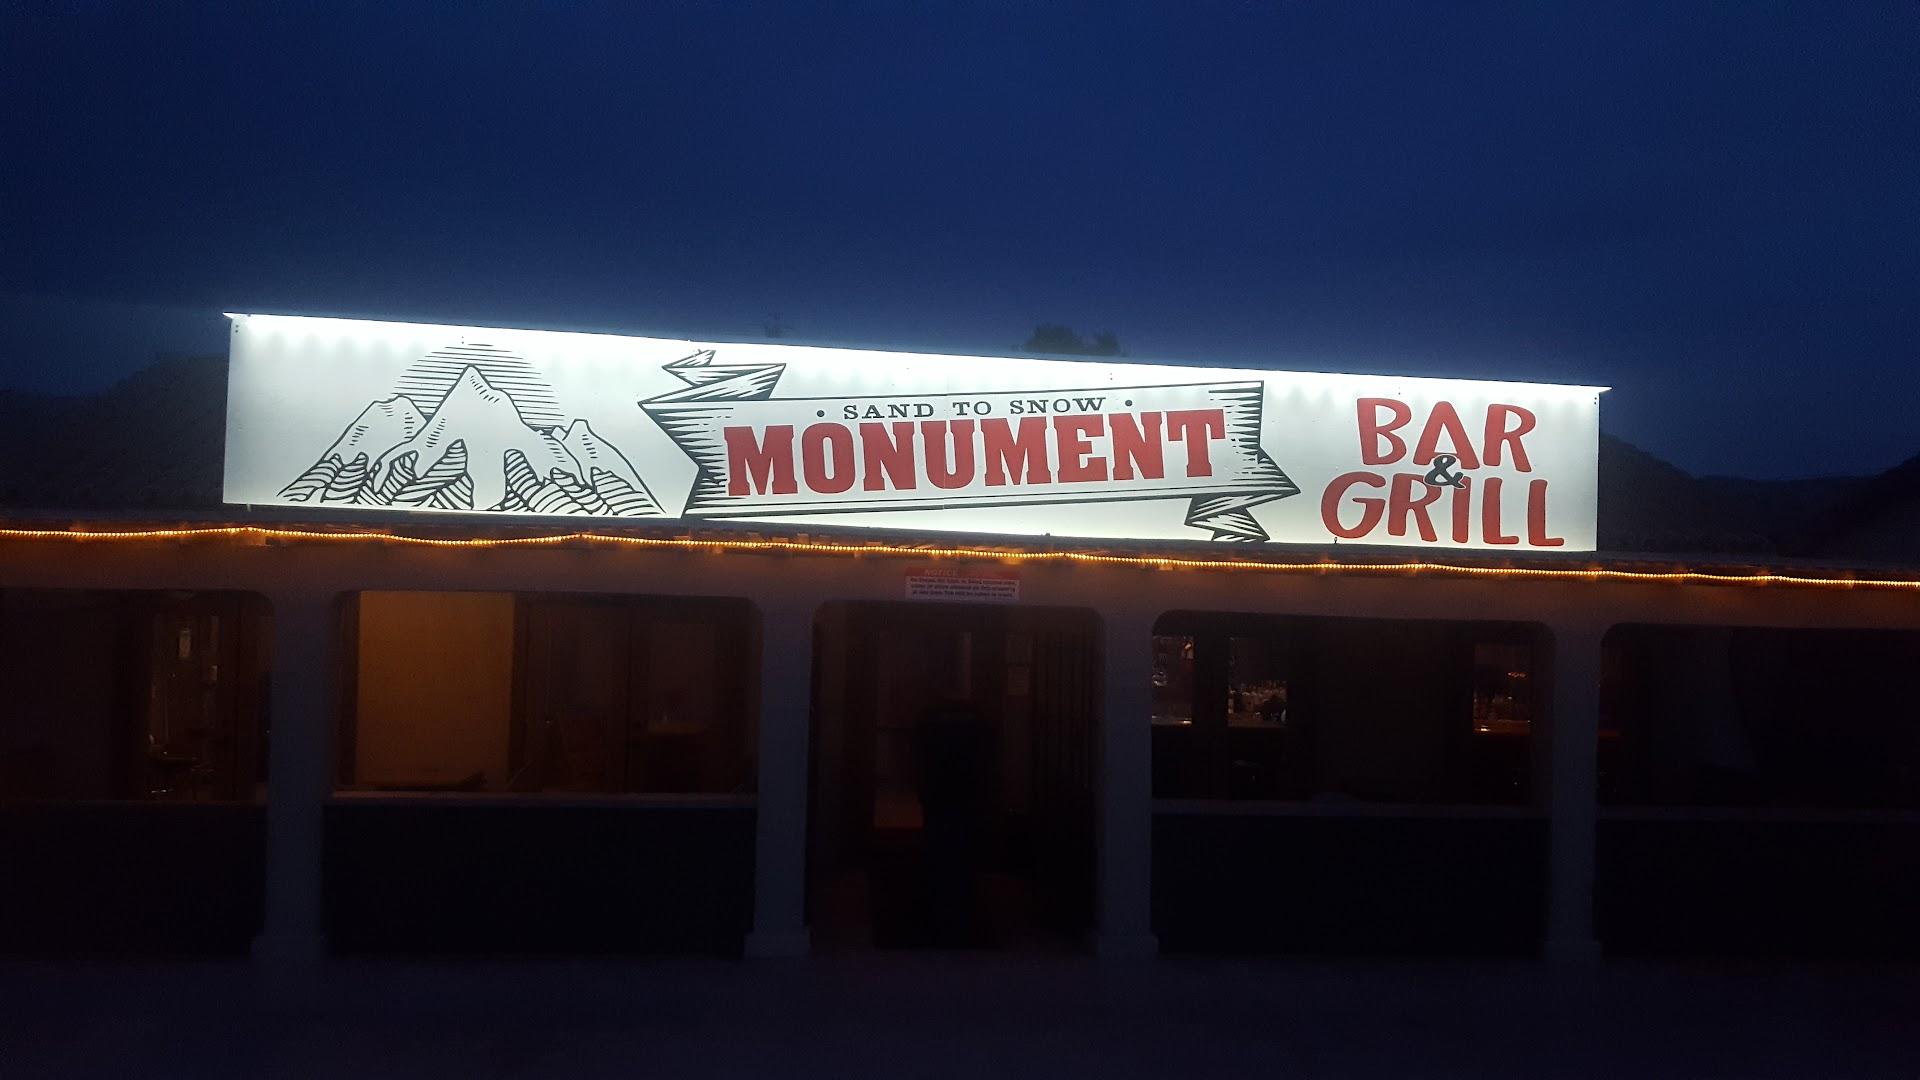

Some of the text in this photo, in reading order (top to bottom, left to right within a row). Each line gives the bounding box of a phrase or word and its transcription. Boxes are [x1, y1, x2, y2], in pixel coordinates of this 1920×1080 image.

[843, 396, 1107, 420] SAND TO SNOW
[1356, 397, 1537, 473] BAR
[722, 408, 1226, 497] MONUMENT
[1424, 454, 1466, 489] &
[1320, 471, 1565, 547] GRILL
